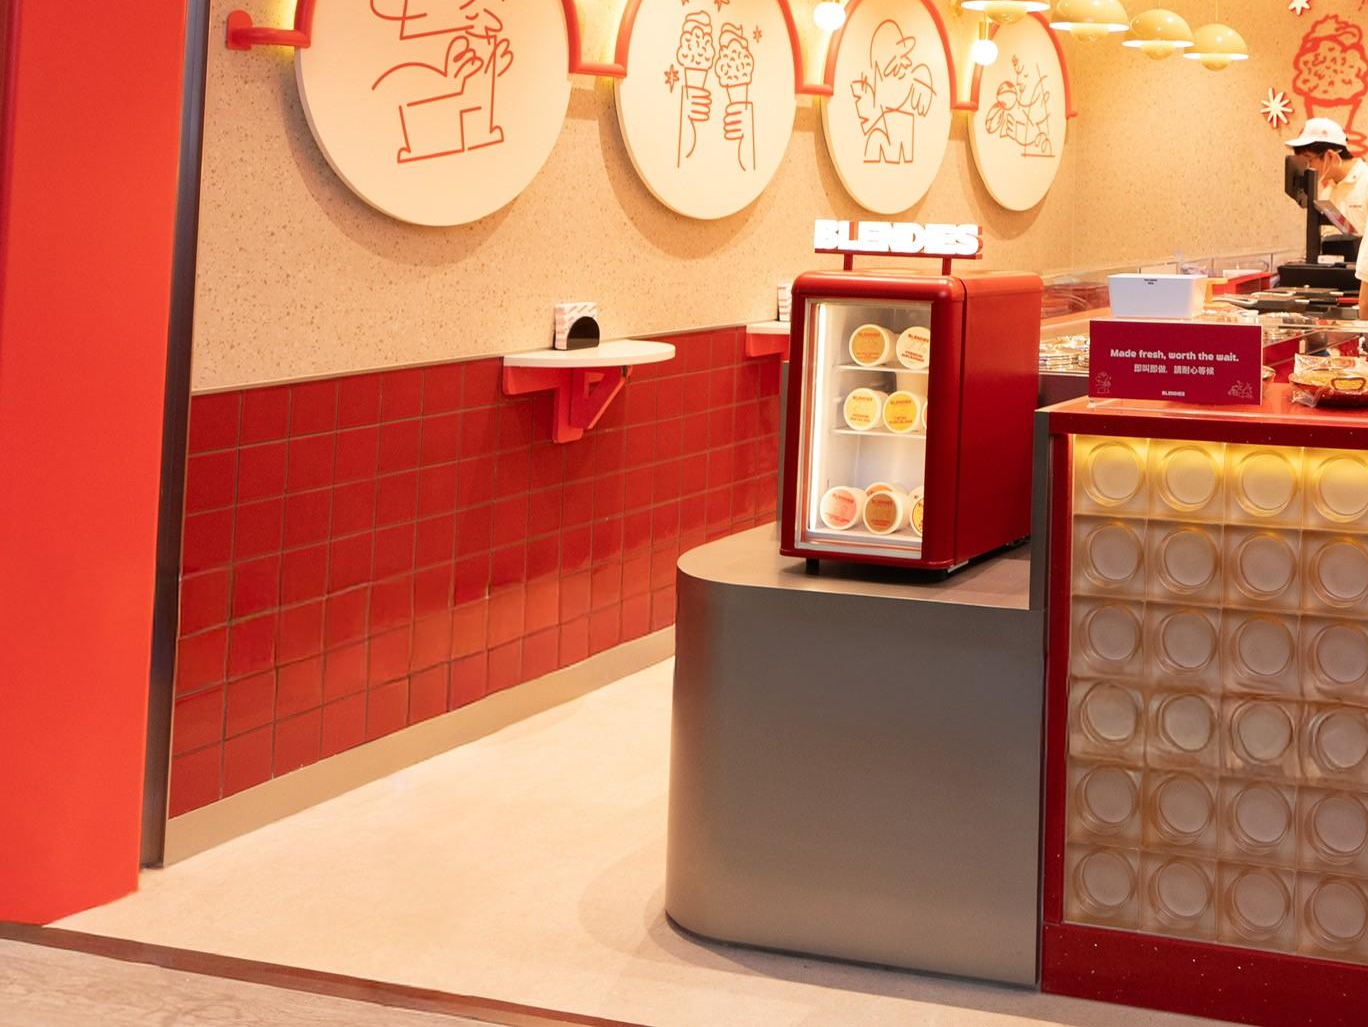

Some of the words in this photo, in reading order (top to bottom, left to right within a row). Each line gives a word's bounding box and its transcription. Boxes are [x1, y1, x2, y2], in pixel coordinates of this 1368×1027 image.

[813, 218, 981, 255] BLENDIES
[1110, 349, 1136, 358] Made
[1139, 349, 1167, 360] fresh,
[1168, 351, 1196, 360] worth
[1198, 352, 1214, 361] the
[1216, 352, 1239, 362] wait.
